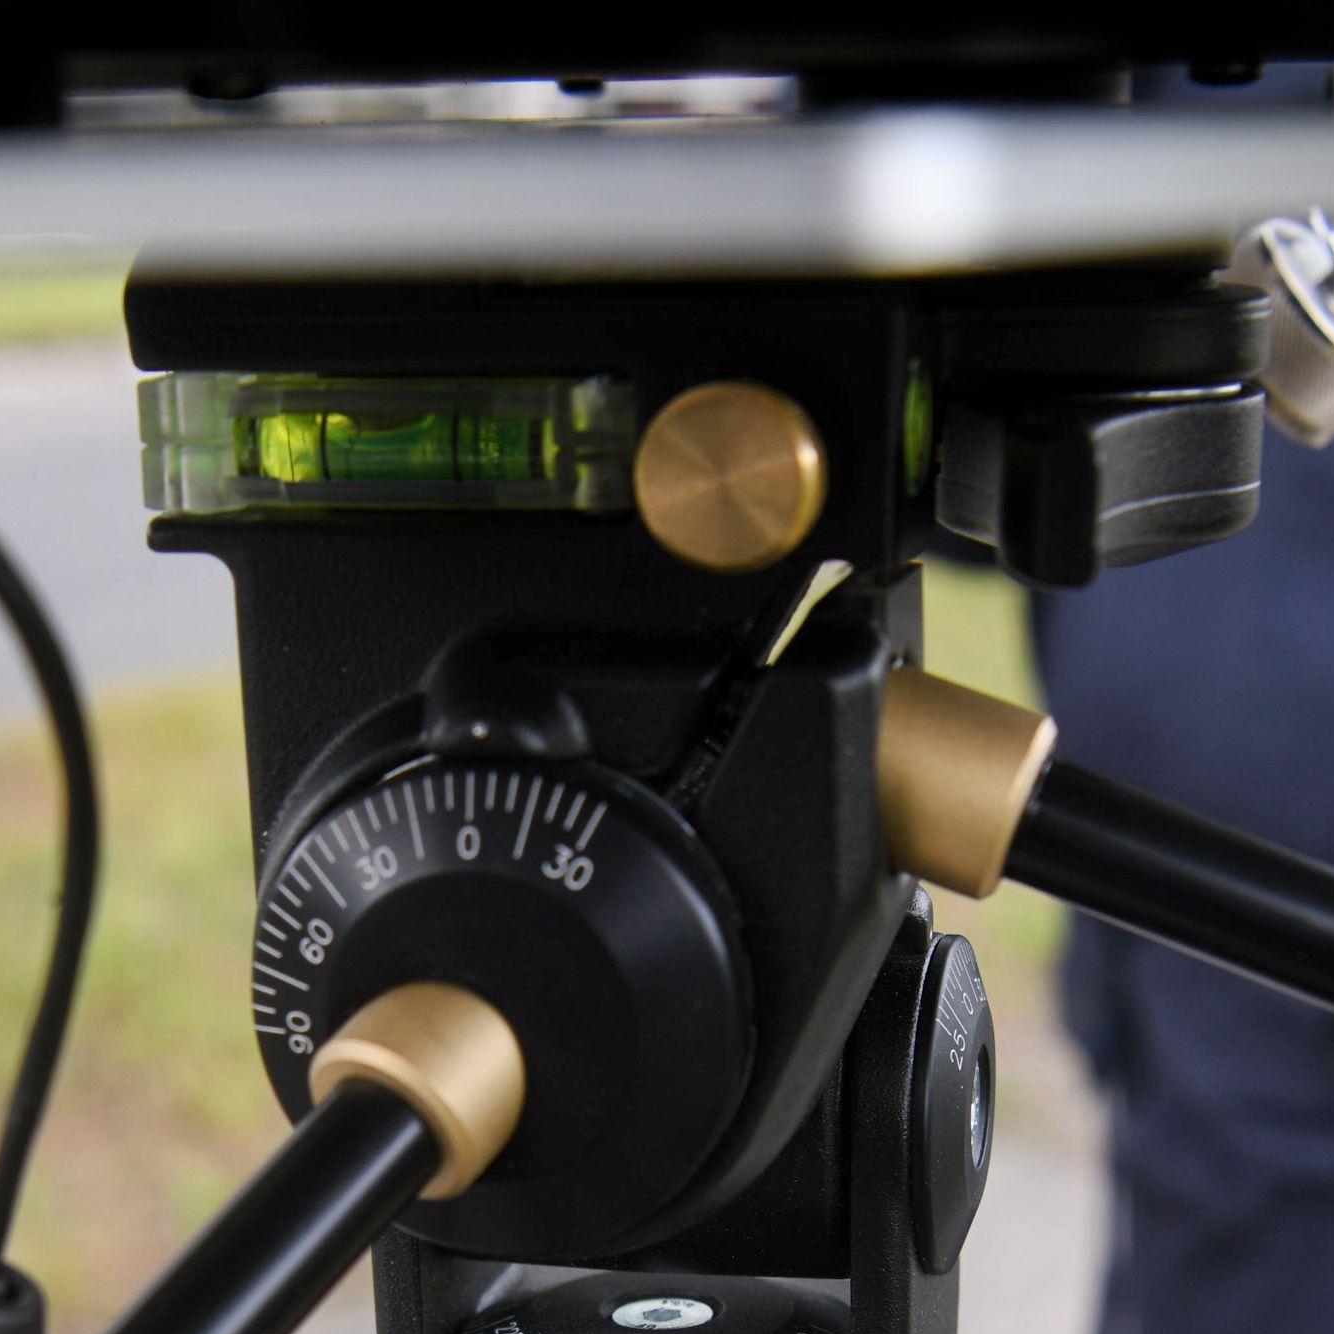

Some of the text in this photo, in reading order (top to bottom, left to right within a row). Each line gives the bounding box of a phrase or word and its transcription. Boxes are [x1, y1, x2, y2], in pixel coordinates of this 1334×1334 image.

[456, 823, 482, 861] 0
[354, 844, 400, 891] 30
[540, 842, 596, 892] 30
[297, 917, 335, 965] 60
[961, 991, 974, 1016] 0
[285, 1008, 315, 1055] 90
[949, 1028, 967, 1072] 25
